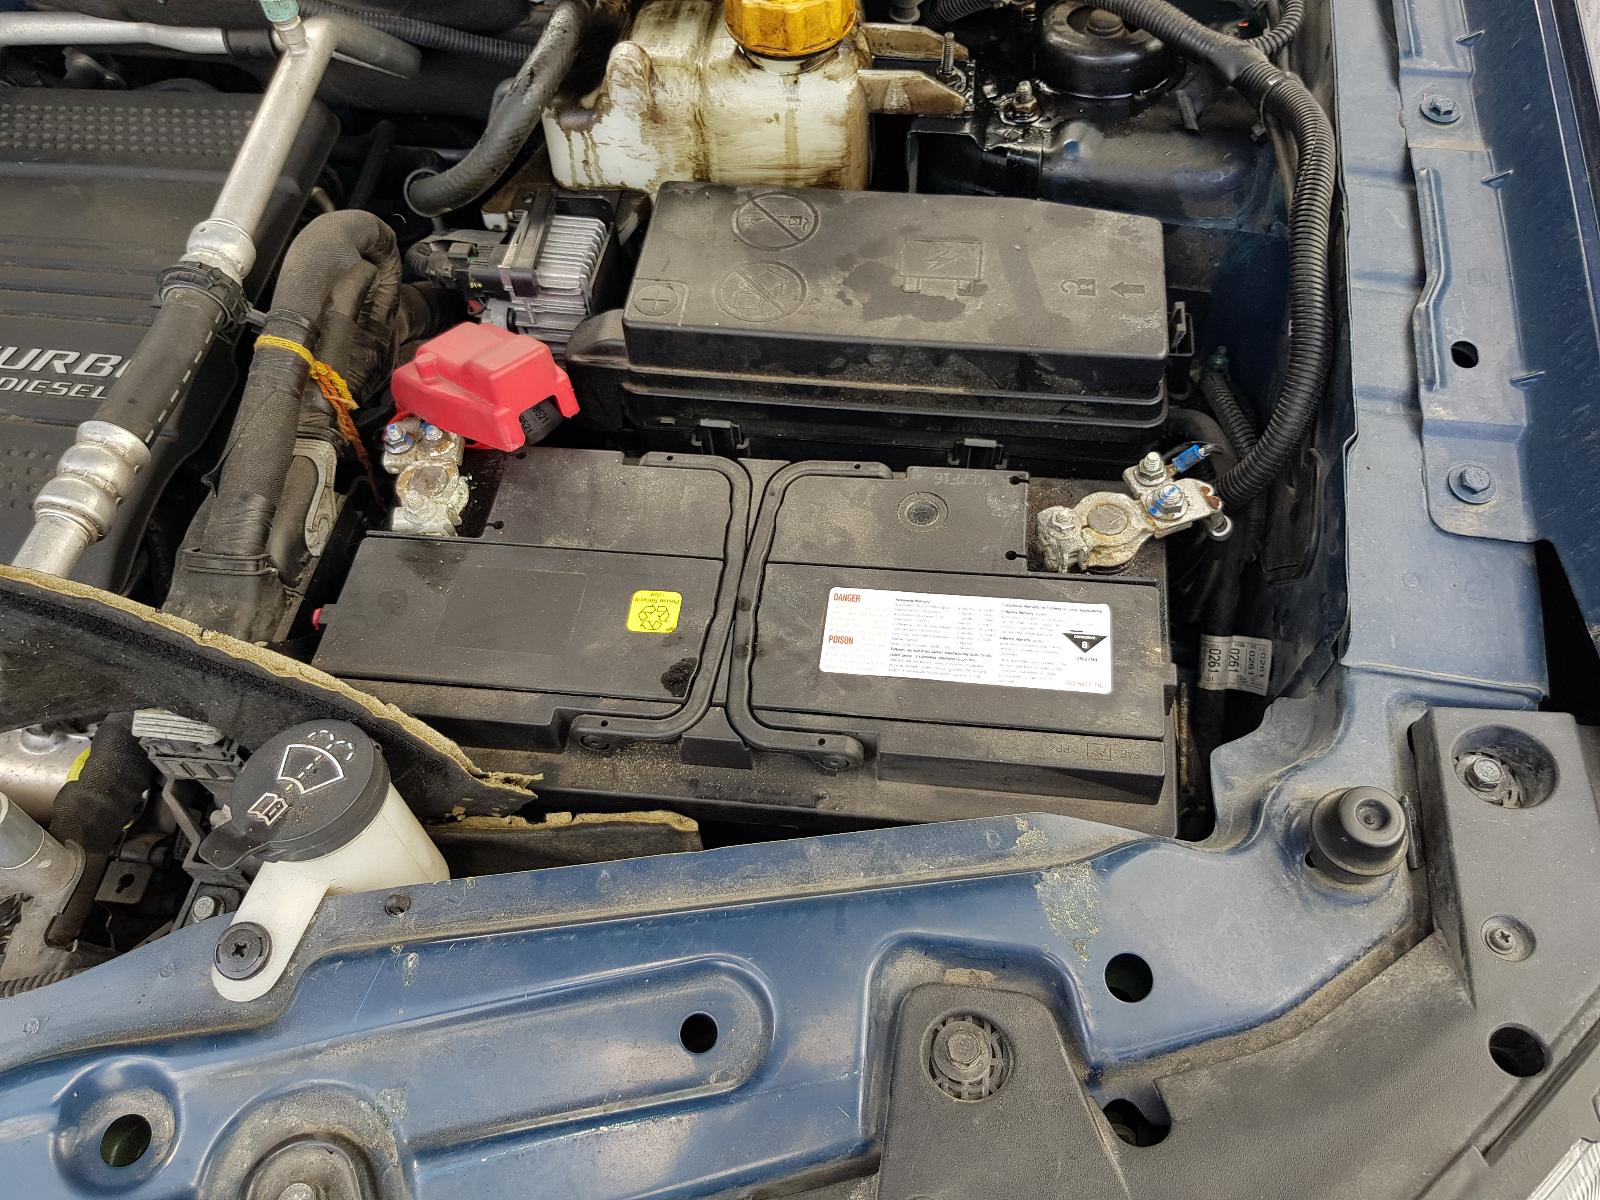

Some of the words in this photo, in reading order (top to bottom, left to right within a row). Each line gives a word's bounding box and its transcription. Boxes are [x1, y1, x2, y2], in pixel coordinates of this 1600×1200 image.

[0, 345, 131, 378] URB
[0, 376, 108, 400] DIESEL
[833, 592, 861, 603] DANGER
[828, 634, 854, 645] POISON
[1207, 648, 1221, 673] 0261
[1228, 648, 1240, 673] 0261
[1248, 650, 1256, 675] 0261
